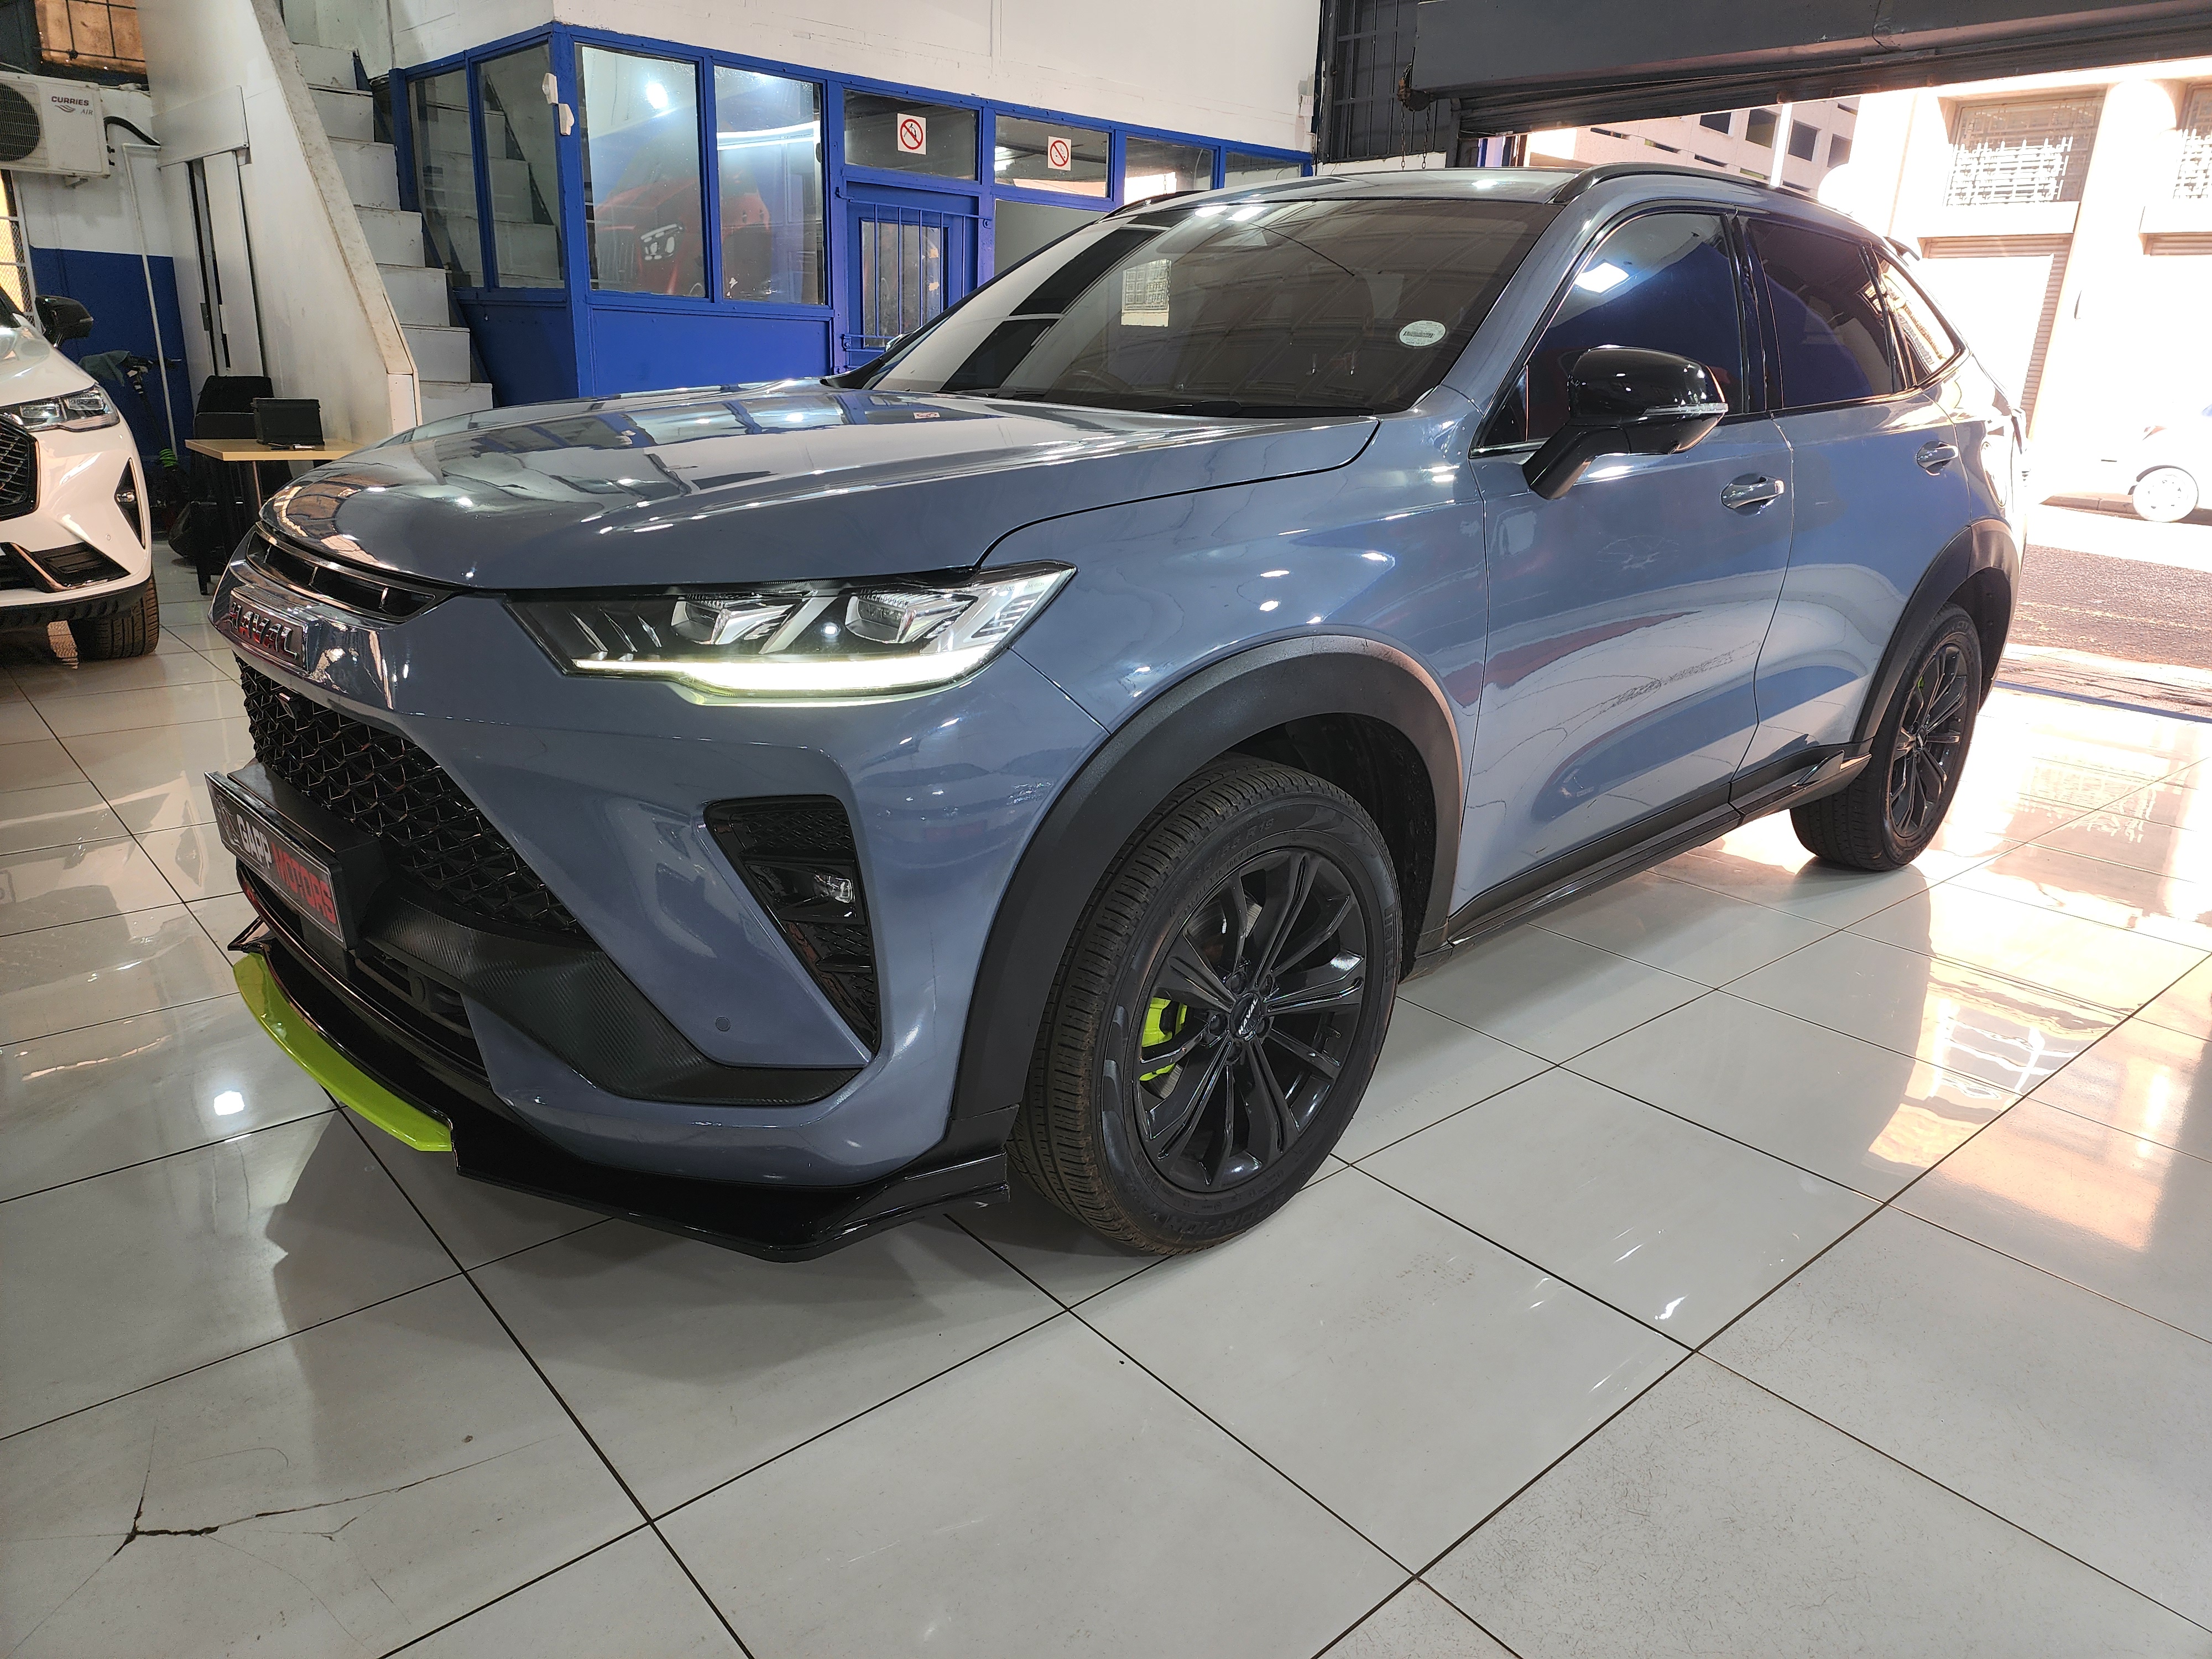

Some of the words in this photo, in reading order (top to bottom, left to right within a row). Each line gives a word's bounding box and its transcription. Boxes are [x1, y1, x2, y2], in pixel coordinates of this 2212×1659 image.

[51, 96, 90, 106] CURRIES
[229, 601, 298, 660] HAVAL
[236, 813, 273, 869] GAPP
[270, 841, 337, 925] MOTORS
[1384, 902, 1396, 983] PIRELLI
[1239, 998, 1258, 1035] HAVAL
